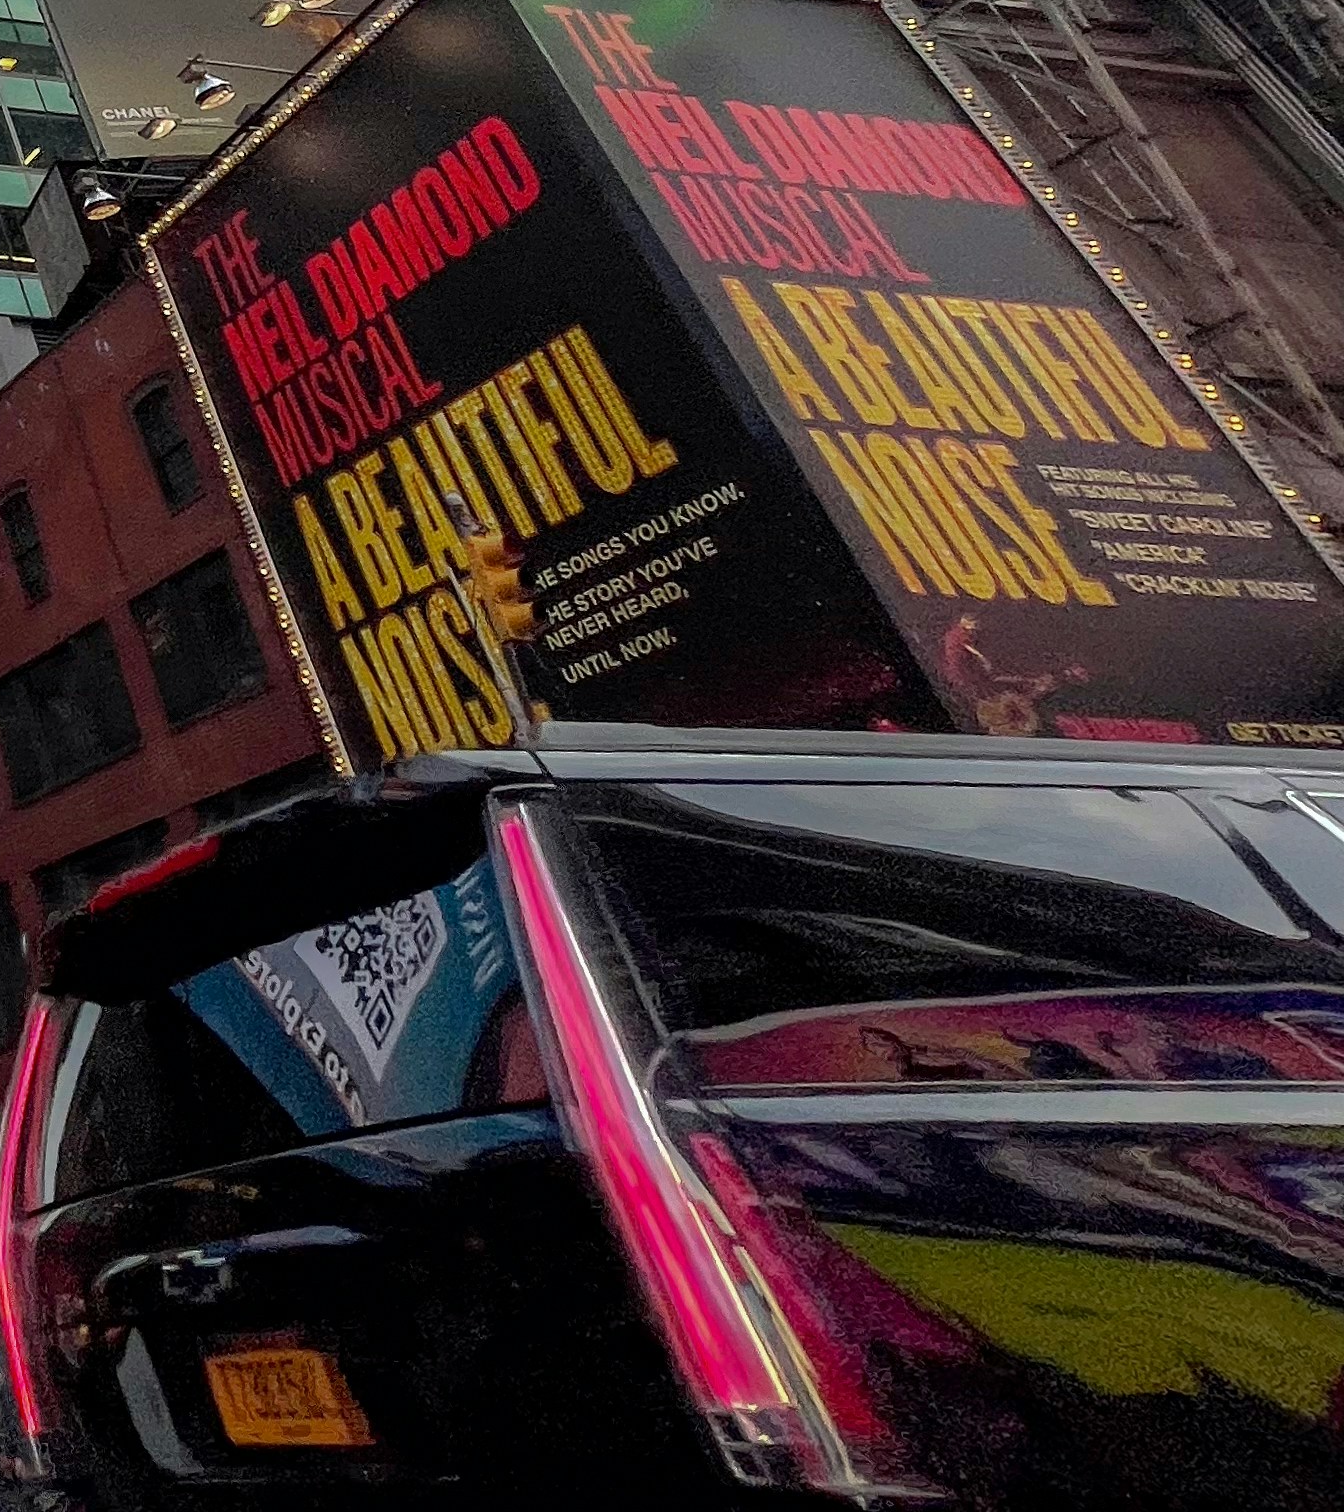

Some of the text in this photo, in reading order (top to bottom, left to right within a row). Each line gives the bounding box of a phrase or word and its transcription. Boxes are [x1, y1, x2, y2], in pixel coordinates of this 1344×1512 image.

[543, 3, 675, 88] THE
[102, 106, 180, 120] CHANEL
[595, 88, 1034, 206] NEIL DIAMOND
[194, 208, 276, 313] THE
[223, 116, 542, 398] NEIL DIAMOND
[653, 172, 931, 283] MUSICAL
[254, 313, 443, 486] MUSICAL
[721, 276, 1213, 452] A BEAUTIFUL
[294, 323, 679, 631] A BEAUTIFUL
[808, 430, 1117, 606] NOISE
[546, 537, 717, 624] HE STORY YOU'VE
[557, 537, 625, 579] SONGS
[624, 516, 669, 546] YOU
[340, 576, 516, 763] NOIS
[545, 611, 611, 650] NEVER
[561, 627, 677, 684] UNTIL NOW.
